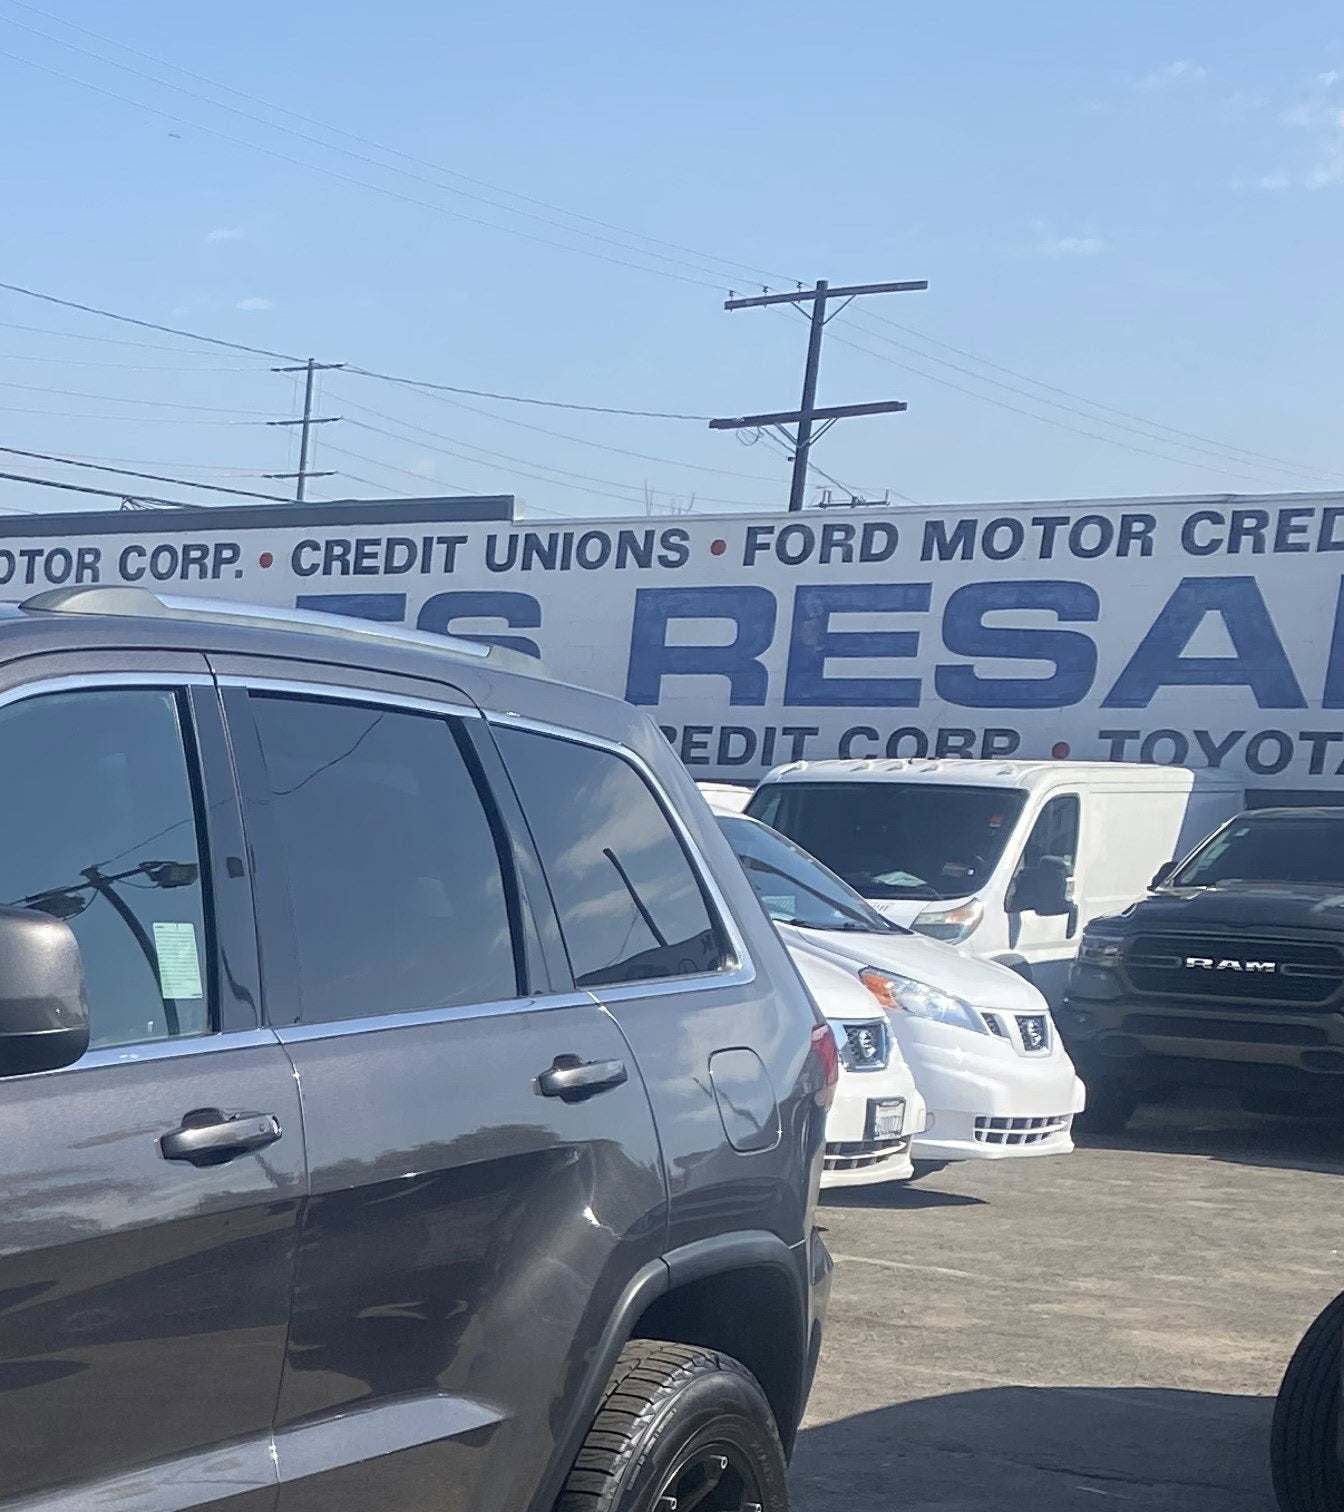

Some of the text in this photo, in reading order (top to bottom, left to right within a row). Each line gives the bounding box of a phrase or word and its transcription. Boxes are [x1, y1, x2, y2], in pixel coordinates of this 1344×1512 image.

[119, 542, 244, 582] CORP.
[291, 527, 690, 578] CREDIT UNIONS
[742, 521, 900, 568] FORD
[920, 513, 1157, 563] MOTOR
[624, 574, 1344, 709] RESA
[1099, 729, 1344, 776] TOYOT
[1185, 957, 1276, 972] RAM
